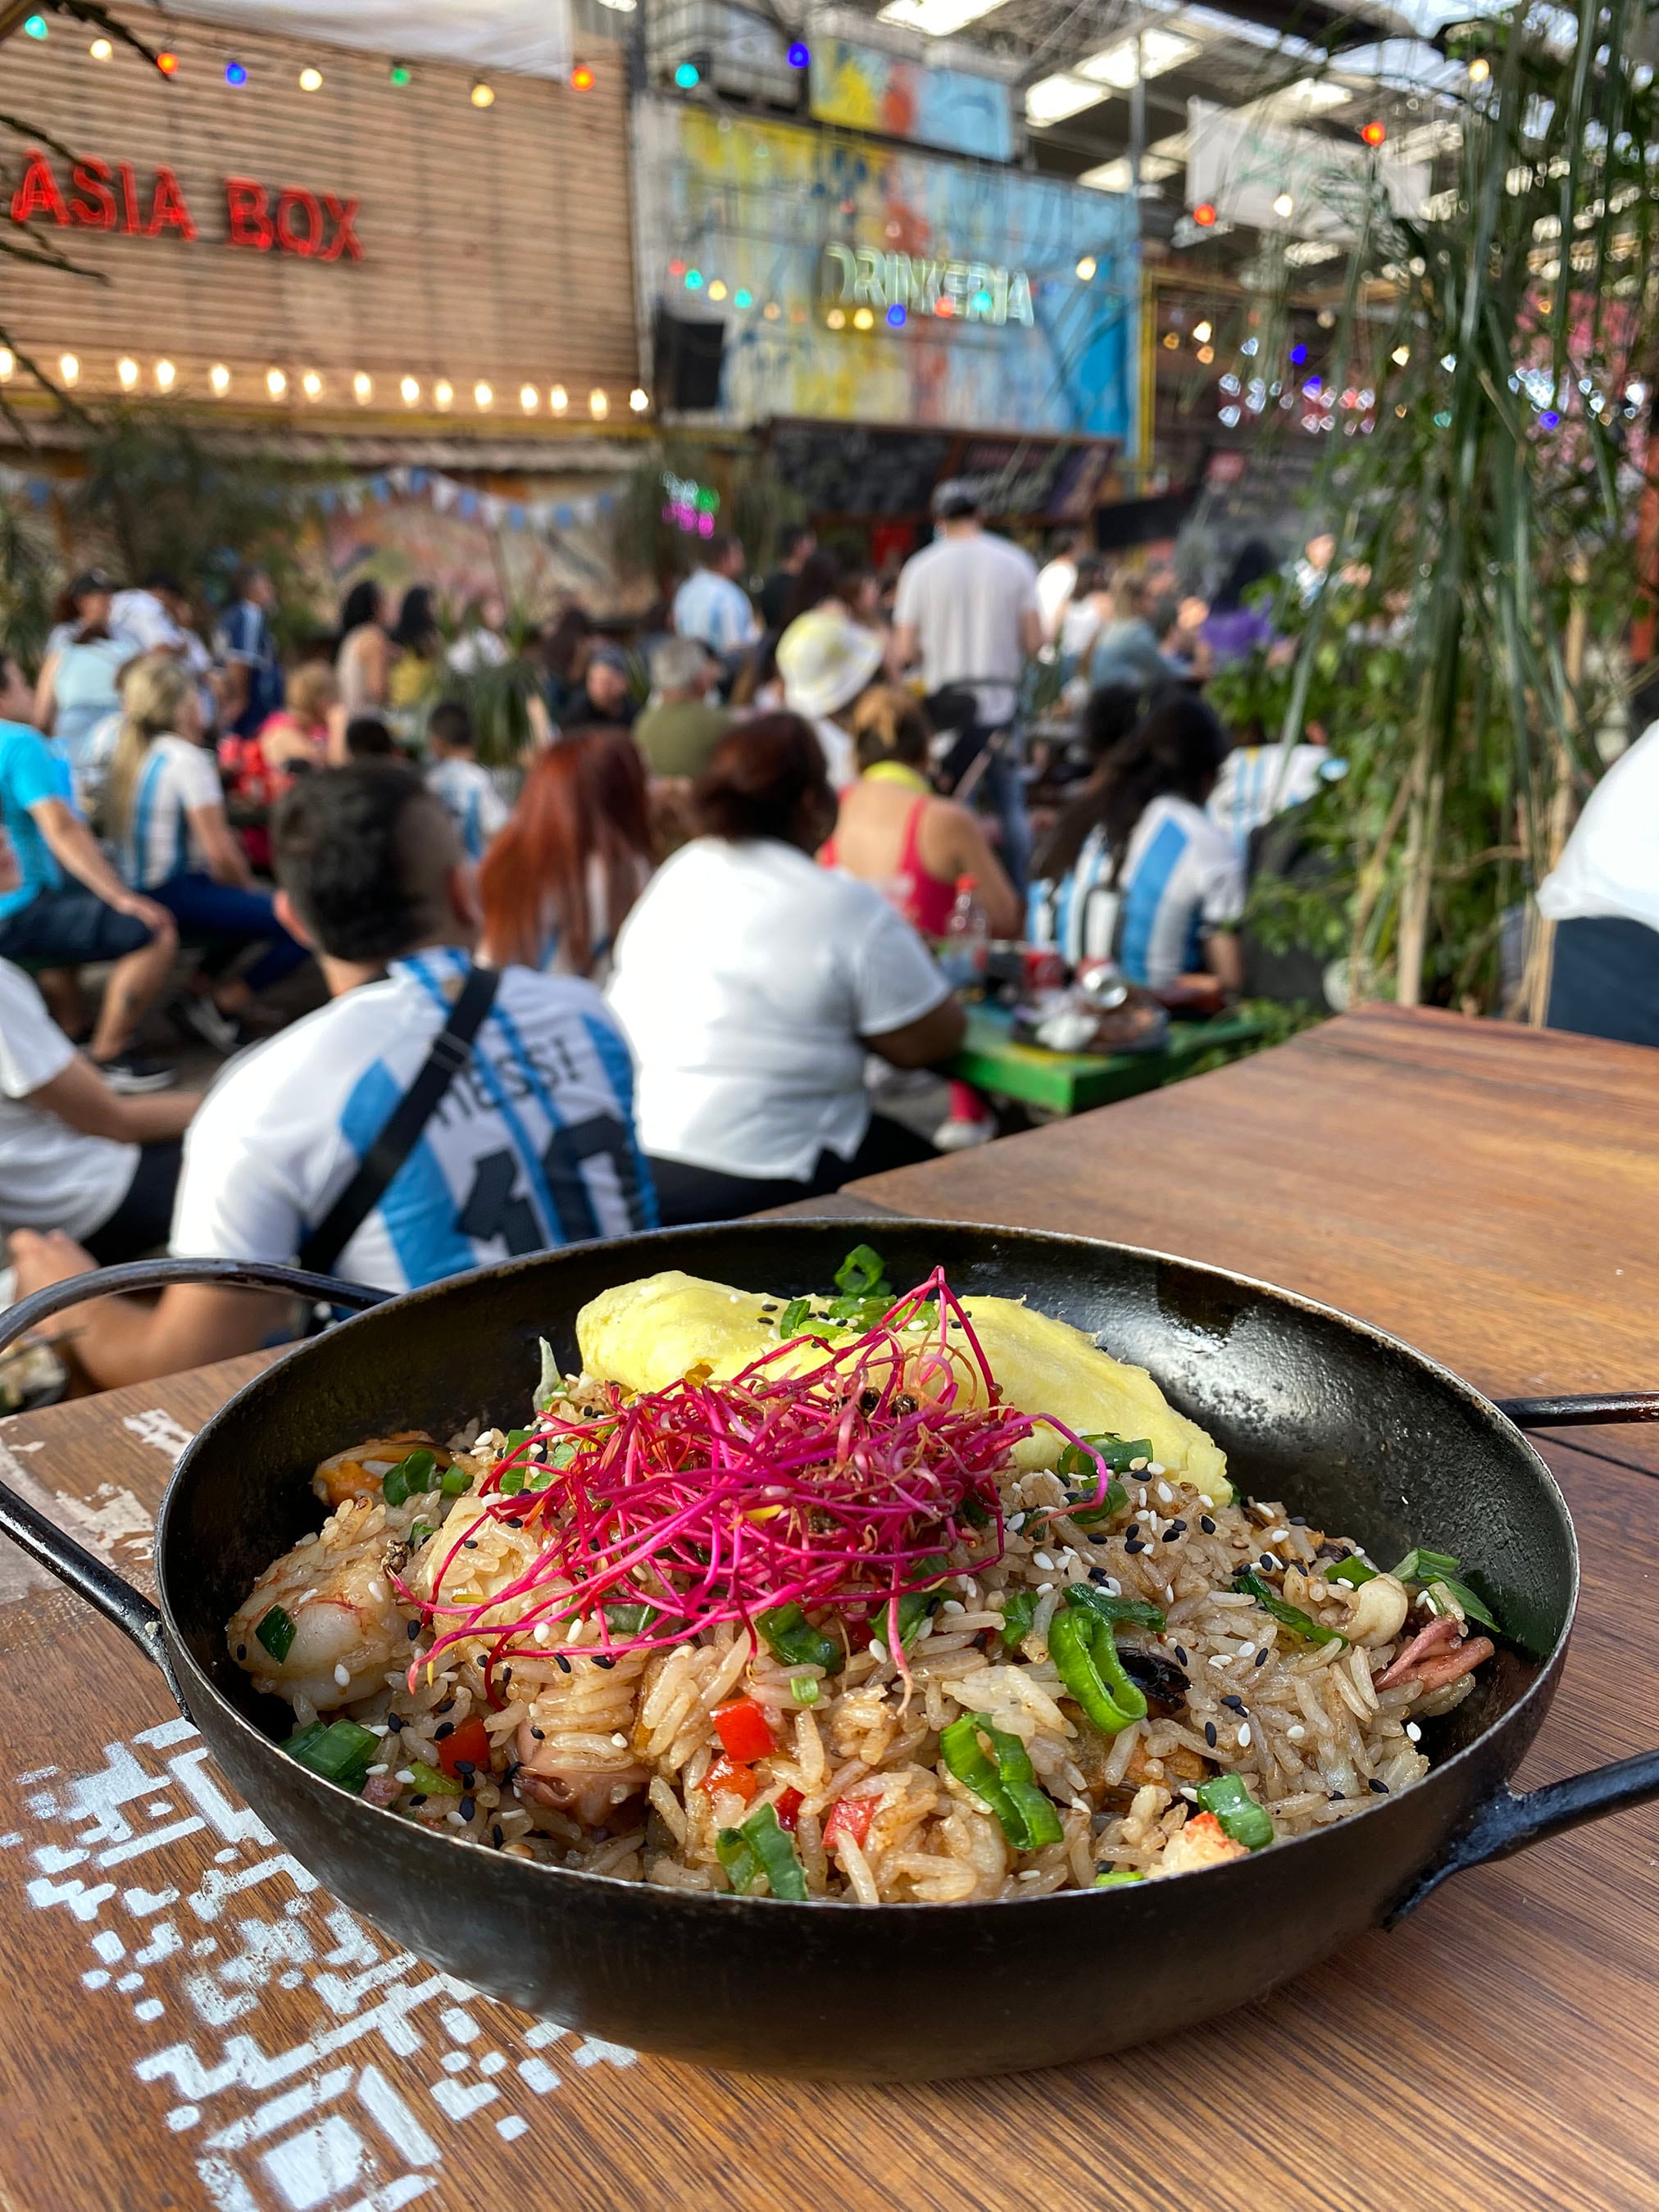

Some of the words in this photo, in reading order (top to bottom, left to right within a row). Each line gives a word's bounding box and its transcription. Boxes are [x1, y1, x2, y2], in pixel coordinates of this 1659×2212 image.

[11, 148, 198, 243] ASIA
[225, 175, 365, 262] BOX
[823, 241, 1034, 327] DRINKERIA
